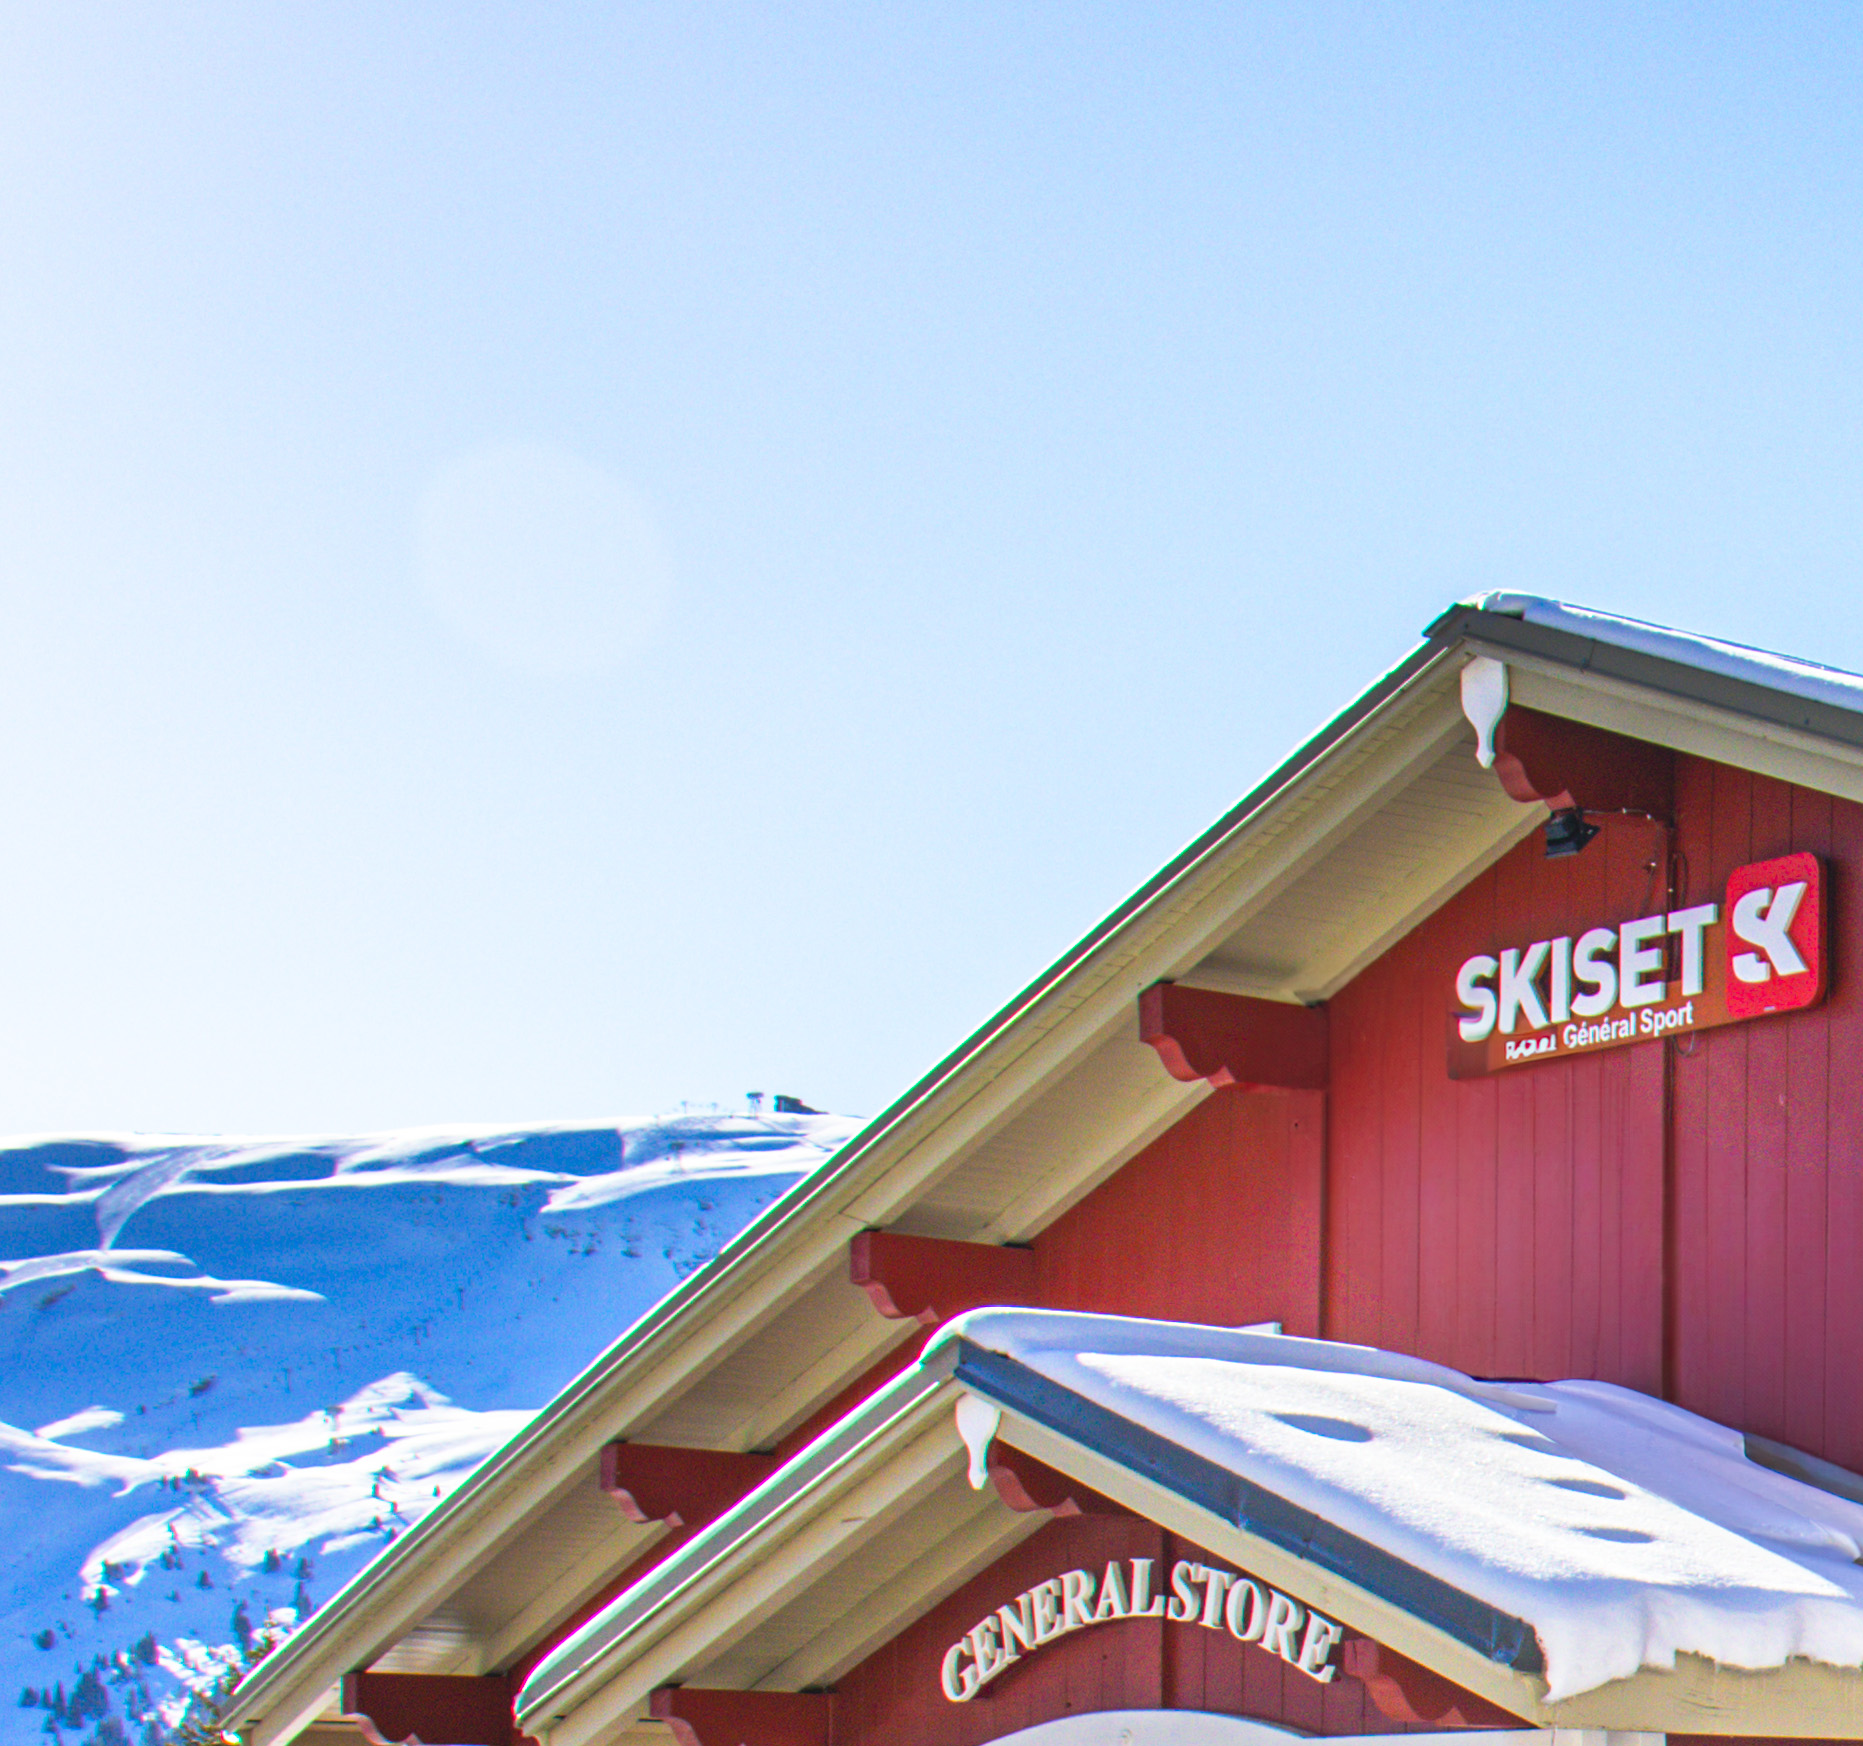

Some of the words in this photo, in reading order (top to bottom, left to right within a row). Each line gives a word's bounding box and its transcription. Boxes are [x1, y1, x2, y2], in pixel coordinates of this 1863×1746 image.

[1456, 902, 1718, 1042] SKISET
[1563, 1011, 1637, 1048] Général
[1640, 1000, 1694, 1037] Sport
[941, 1558, 1164, 1702] GENERAL
[1167, 1560, 1343, 1683] STORE
